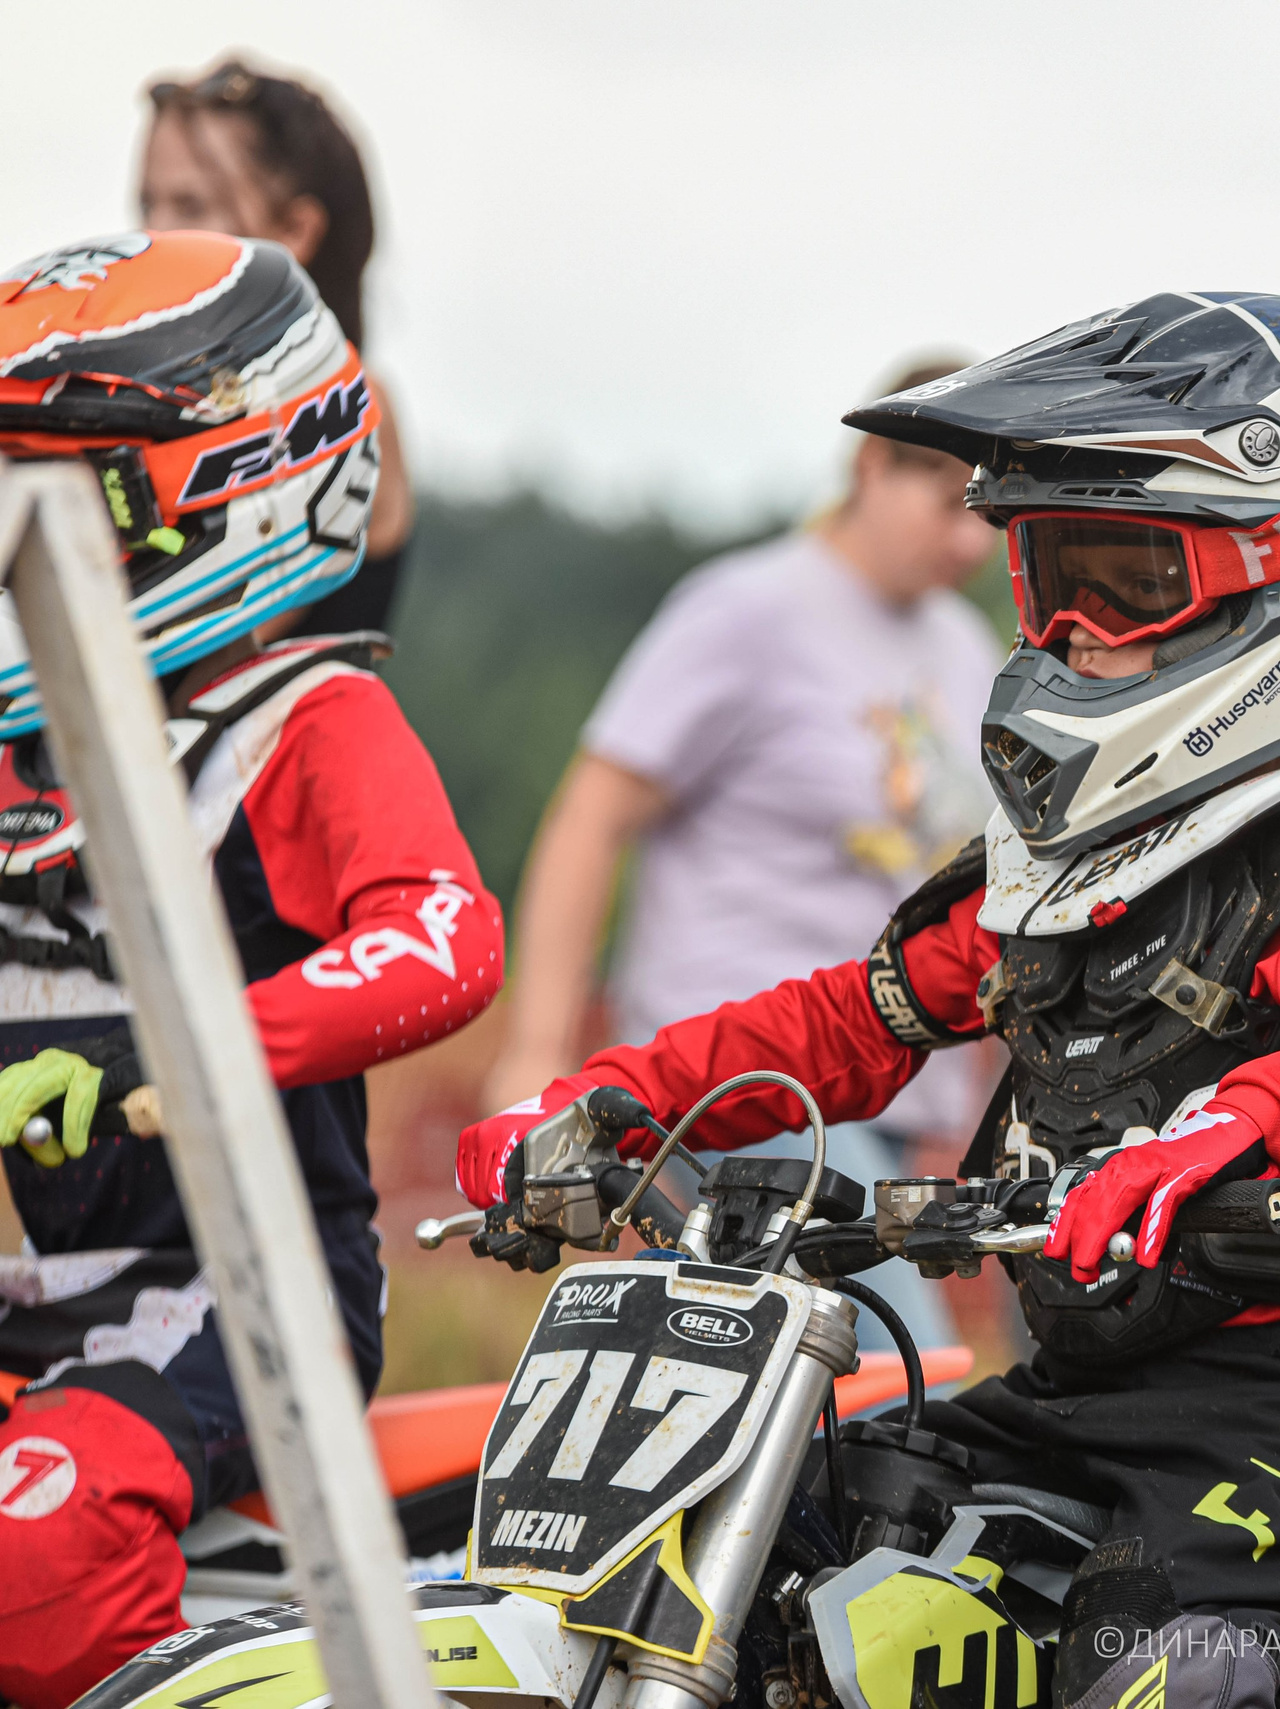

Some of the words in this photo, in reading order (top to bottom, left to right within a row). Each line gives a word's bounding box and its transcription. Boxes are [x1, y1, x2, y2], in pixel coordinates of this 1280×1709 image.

[1110, 953, 1139, 981] THREE
[1146, 934, 1167, 957] FIVE
[1065, 1036, 1104, 1058] LEATT
[491, 1130, 518, 1202] LAST
[1099, 1268, 1118, 1287] PRO
[561, 1309, 581, 1319] RACING
[581, 1308, 603, 1318] PARTS
[678, 1312, 741, 1338] BELL
[684, 1328, 731, 1343] HELMETS
[484, 1349, 750, 1493] 717
[1, 1450, 69, 1507] 7
[490, 1509, 588, 1554] MEZIN
[425, 1646, 478, 1663] N_152
